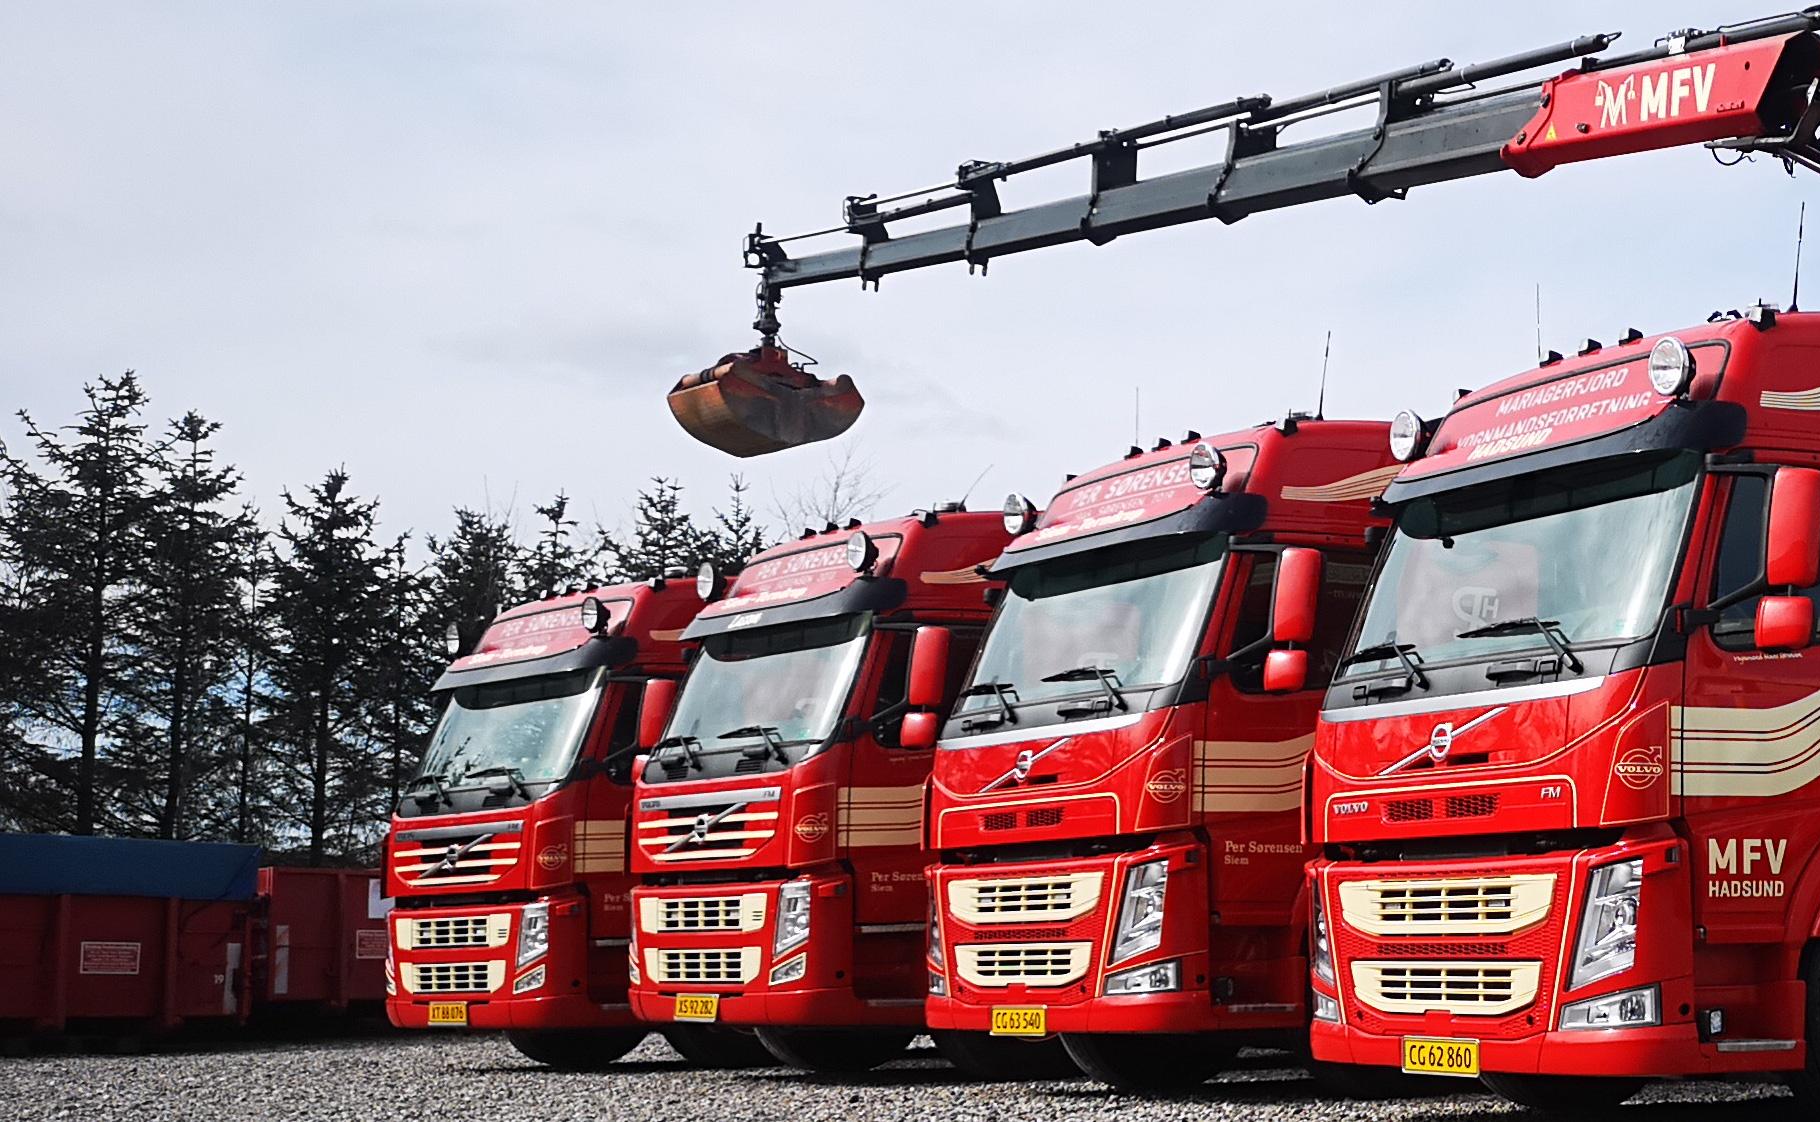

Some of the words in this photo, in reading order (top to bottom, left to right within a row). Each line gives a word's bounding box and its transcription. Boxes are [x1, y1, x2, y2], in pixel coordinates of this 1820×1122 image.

[1640, 63, 1716, 122] MFV
[1496, 368, 1629, 417] MARIAGERFJORD
[1070, 485, 1102, 510] PER
[1105, 462, 1190, 499] SØRENSE
[1617, 765, 1661, 773] VOLVO
[1540, 786, 1561, 799] FM
[1333, 801, 1368, 815] VOLVO
[1224, 840, 1246, 853] Per
[1248, 841, 1303, 854] Sørensen
[1224, 854, 1249, 865] Siem
[1708, 838, 1788, 875] MFV
[1708, 880, 1784, 898] HADSUND
[213, 974, 225, 984] 19
[996, 1012, 1008, 1029] CG
[1009, 1012, 1021, 1029] 63
[1022, 1012, 1041, 1030] 540
[1409, 1045, 1426, 1066] CG
[1428, 1045, 1444, 1067] 62
[1447, 1046, 1472, 1069] 860
